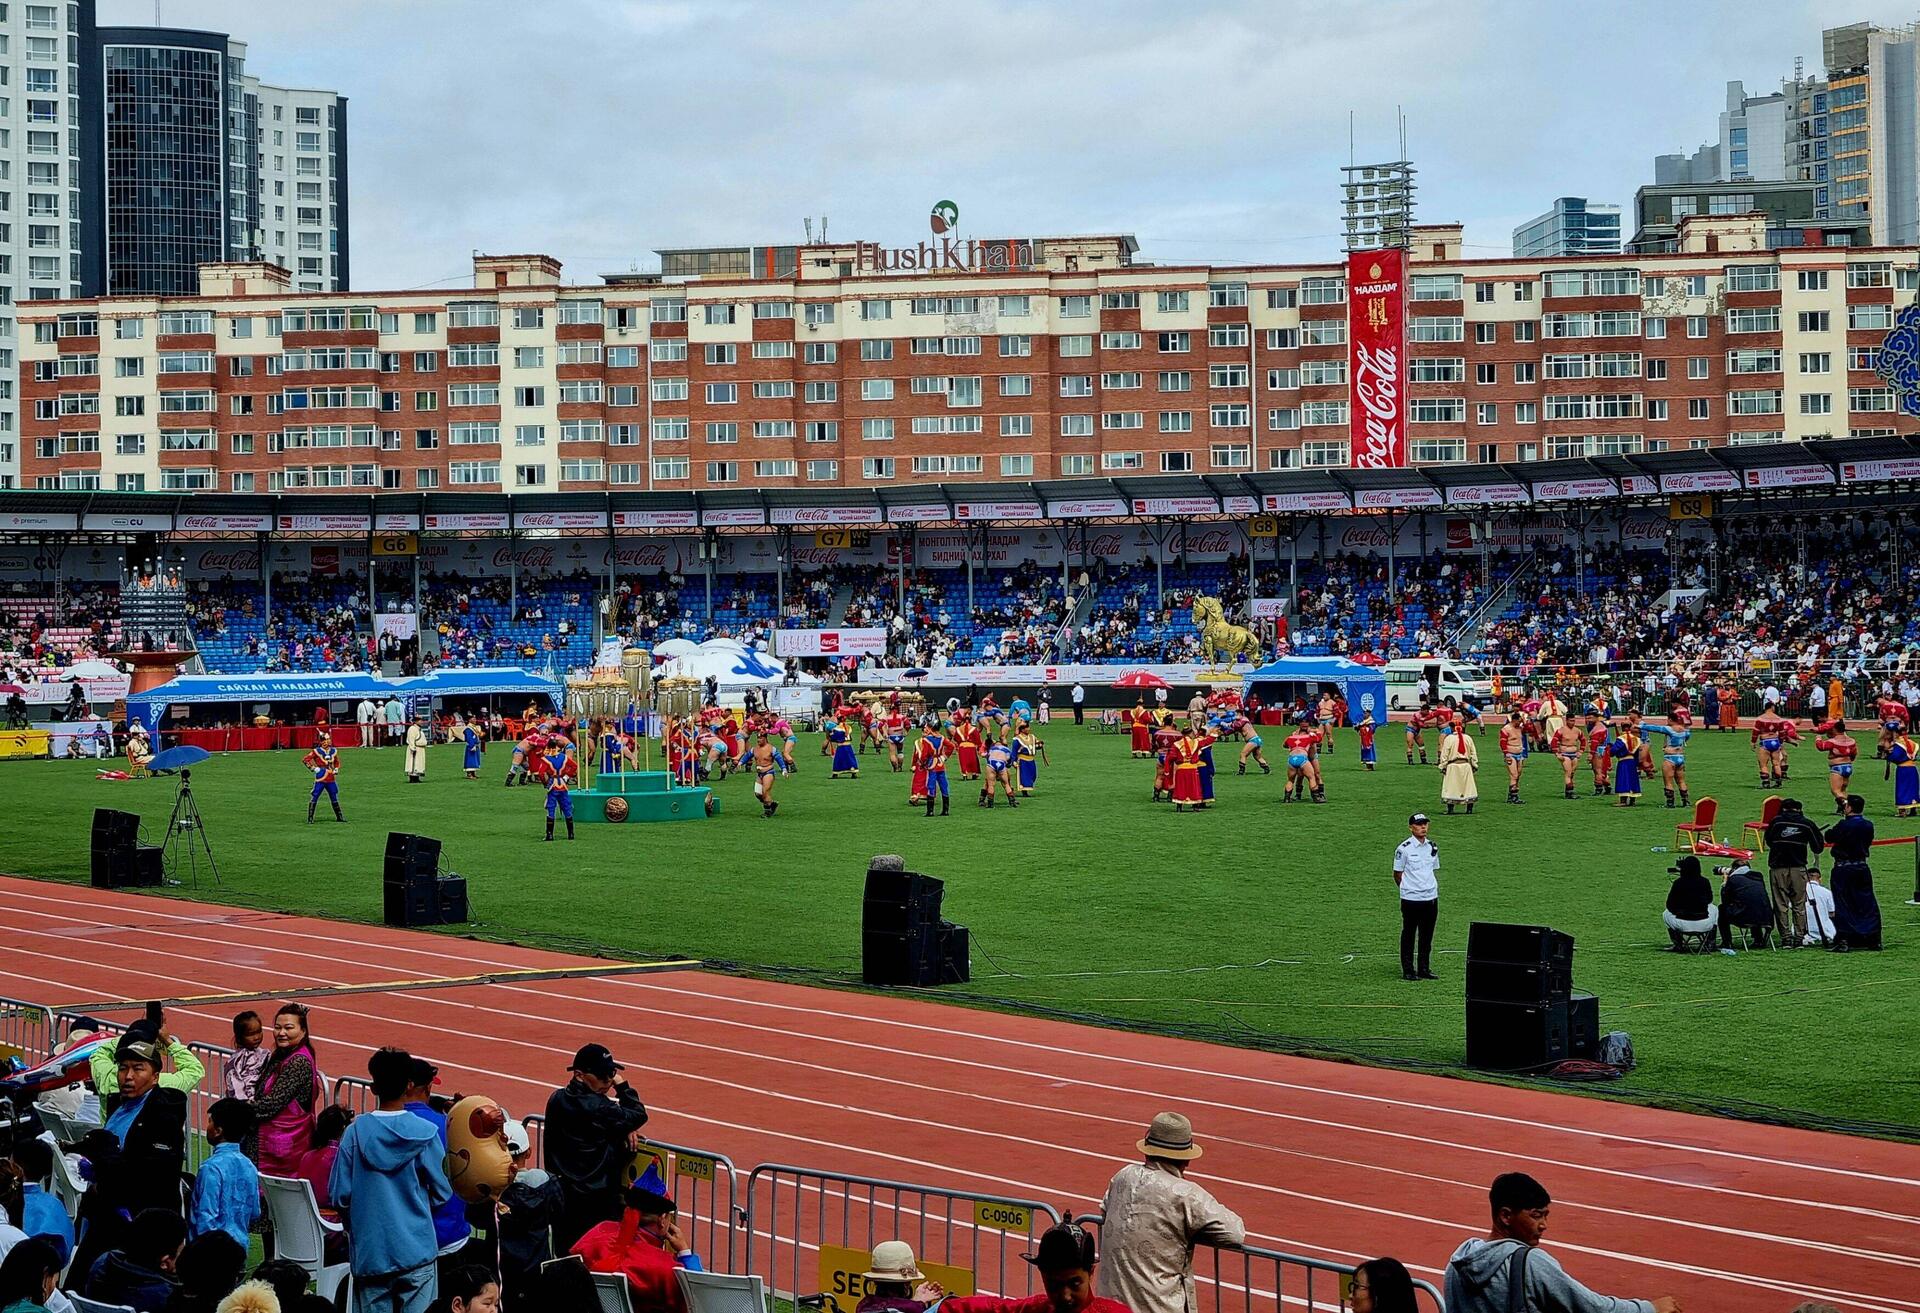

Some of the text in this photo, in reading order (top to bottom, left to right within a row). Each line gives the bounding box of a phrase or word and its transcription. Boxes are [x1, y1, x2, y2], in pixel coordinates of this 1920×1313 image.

[856, 237, 1034, 272] HushKhan
[1680, 499, 1702, 515] G9
[129, 517, 144, 527] CU
[1254, 520, 1273, 533] G8
[821, 531, 845, 546] G7
[851, 530, 869, 540] WC
[918, 536, 951, 547] МОНГОЛ
[383, 538, 407, 552] G6
[217, 680, 345, 692] САЙХАН НААДААРАЙ
[680, 1159, 708, 1175] C-0279
[981, 1207, 1023, 1226] C-0906
